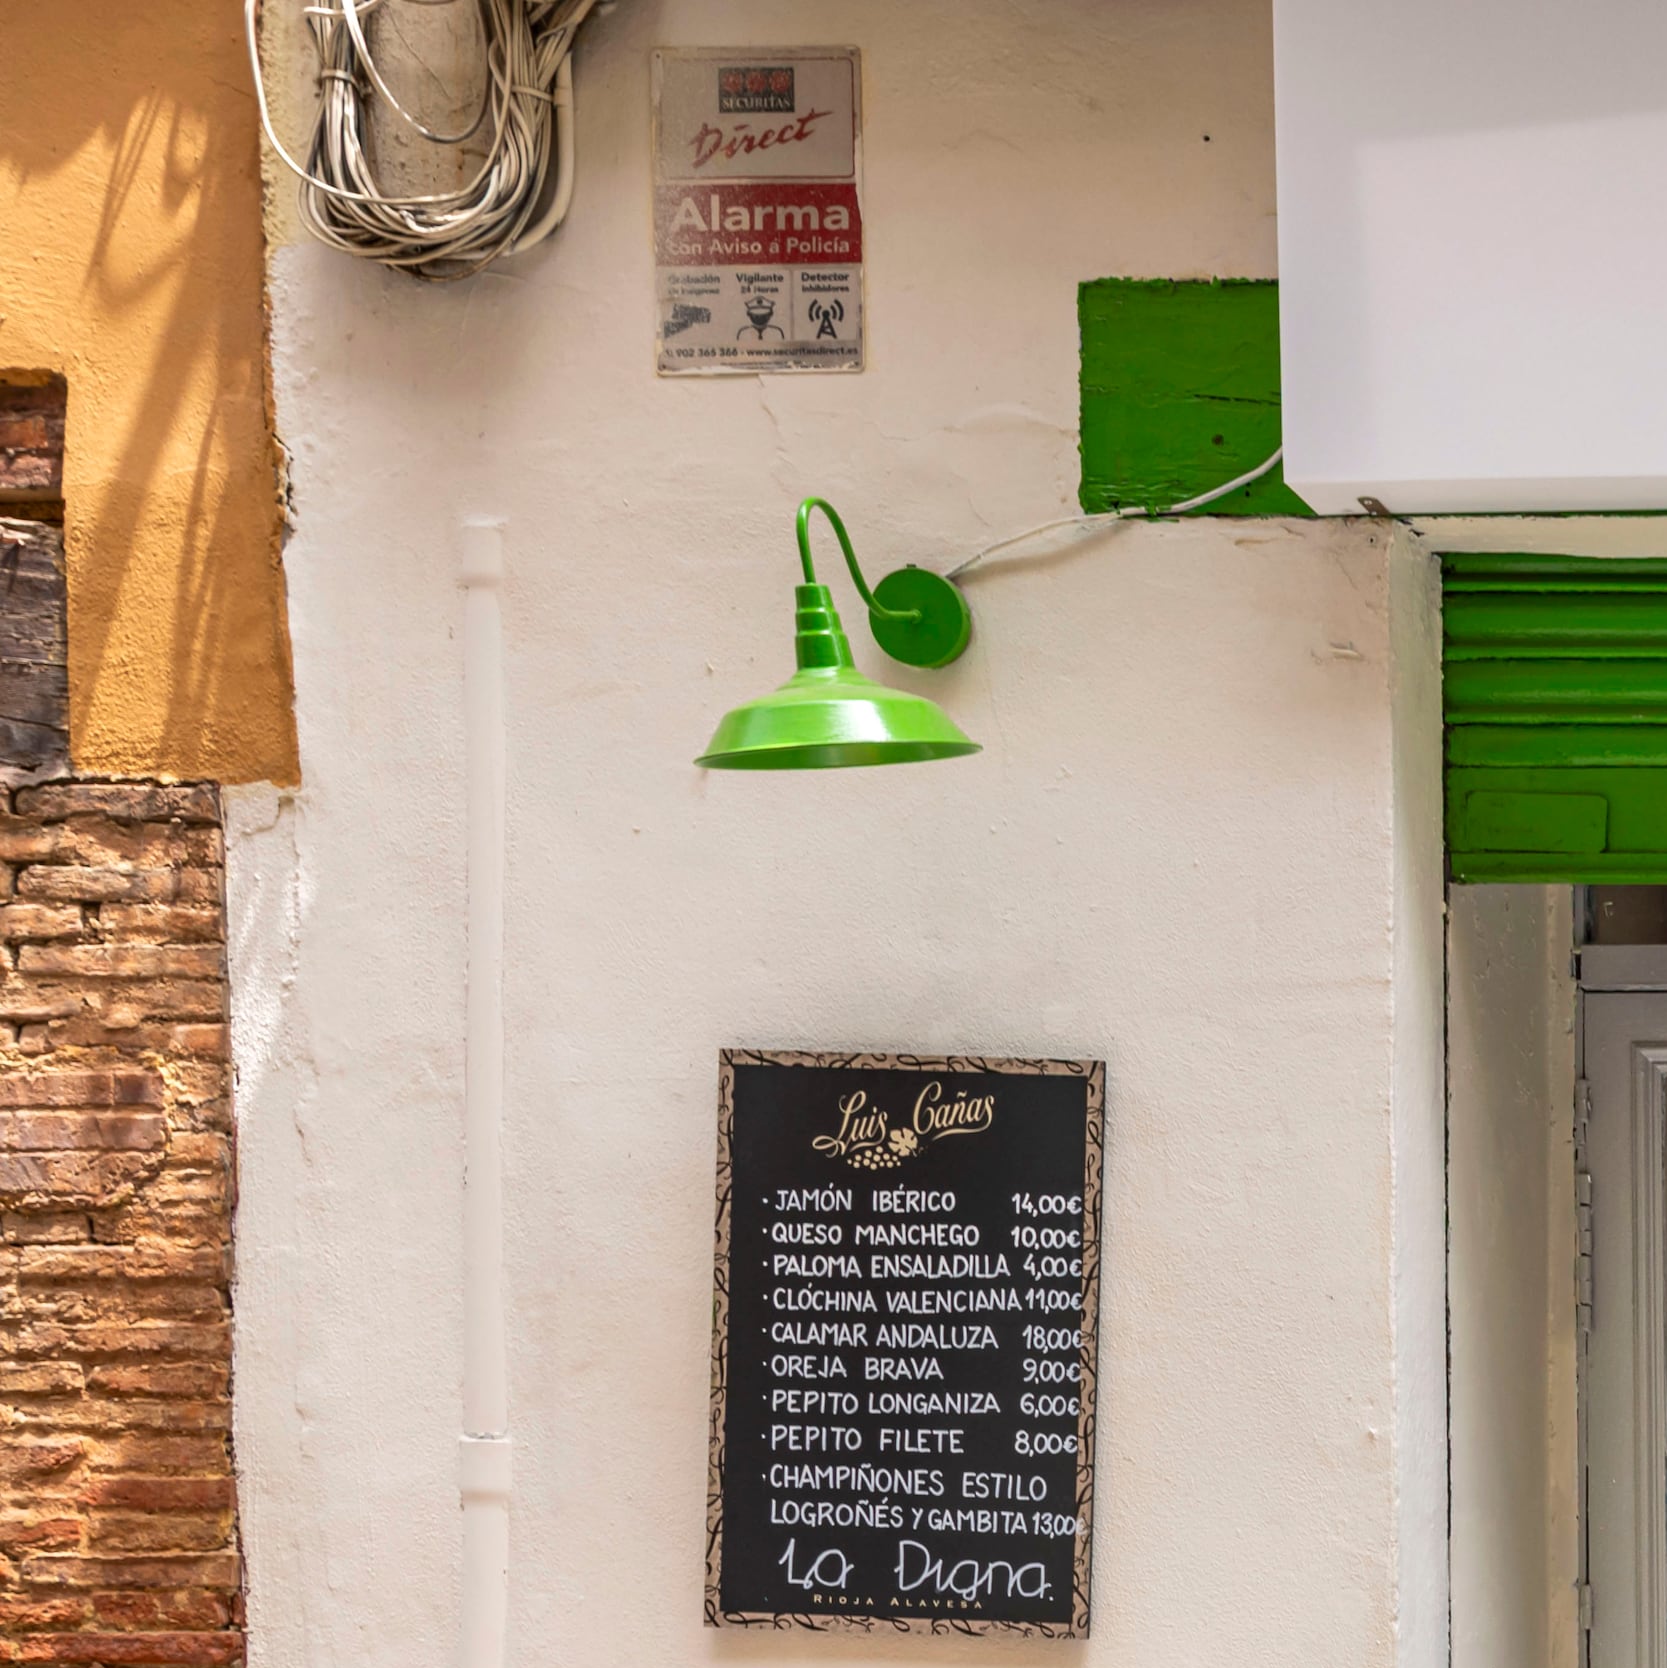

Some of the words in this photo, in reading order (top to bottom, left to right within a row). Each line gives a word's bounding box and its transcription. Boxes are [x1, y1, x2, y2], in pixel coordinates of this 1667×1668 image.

[690, 109, 833, 168] Direct
[672, 194, 849, 231] Alarma
[711, 238, 762, 254] Aviso
[787, 236, 849, 253] Policía
[736, 273, 783, 284] Vigilante
[801, 272, 849, 282] Detector
[676, 348, 696, 358] 902
[812, 1090, 888, 1158] Luis
[913, 1081, 995, 1139] Cañas
[775, 1182, 852, 1212] JAMÓN
[872, 1183, 956, 1214] IBÉRICO
[1011, 1192, 1082, 1218] 14,00€
[771, 1222, 842, 1245] QUESO
[854, 1223, 980, 1247] MANCHEGO
[1010, 1225, 1081, 1250] 10,00€
[773, 1254, 862, 1279] PALOMA
[871, 1253, 1011, 1279] ENSALADILLA
[1023, 1253, 1083, 1281] 4,00€
[773, 1282, 878, 1313] CLÓCHINA
[886, 1287, 1023, 1314] VALENCIANA
[1024, 1287, 1082, 1315] 11,00€
[771, 1322, 868, 1348] CALAMAR
[875, 1323, 999, 1350] ANDALUZA
[1022, 1324, 1082, 1354] 18,00€
[771, 1354, 848, 1379] OREJA
[864, 1357, 944, 1381] BRAVA
[1022, 1358, 1081, 1385] 9,00€
[772, 1389, 859, 1415] PEPITO
[868, 1392, 1001, 1415] LONGANIZA
[1019, 1392, 1081, 1418] 6,00€
[771, 1424, 862, 1452] PEPITO
[879, 1428, 964, 1454] FILETE
[1014, 1429, 1078, 1458] 8,00€
[769, 1463, 945, 1497] CHAMPIÑONES
[962, 1471, 1047, 1501] ESTILO
[770, 1496, 904, 1528] LOGROÑÉS
[911, 1507, 924, 1530] Y
[927, 1508, 1028, 1535] GAMBITA
[778, 1537, 855, 1590] La
[813, 1593, 874, 1606] RIOJA
[890, 1597, 982, 1609] ALAVESA
